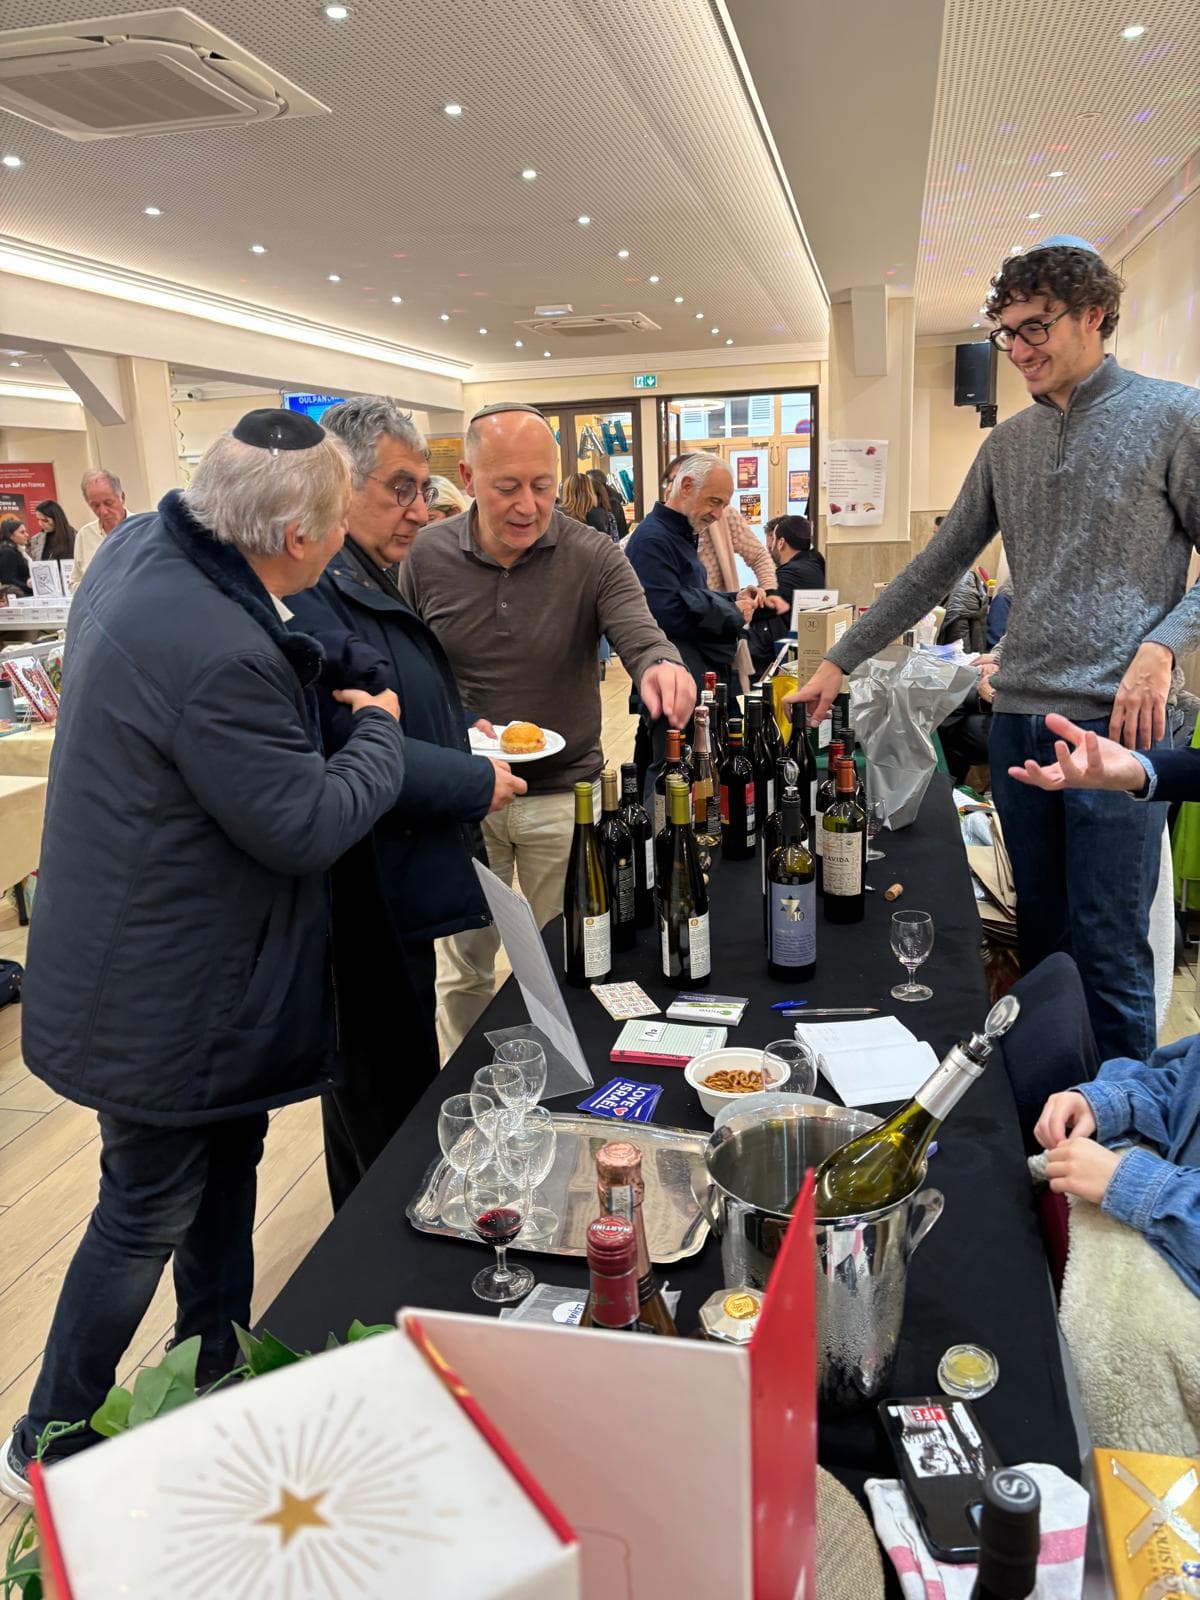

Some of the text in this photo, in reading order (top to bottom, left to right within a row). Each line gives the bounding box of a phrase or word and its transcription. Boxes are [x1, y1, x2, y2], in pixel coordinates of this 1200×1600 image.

[620, 1086, 652, 1108] LOVE
[592, 1224, 631, 1233] MARTINI
[912, 1408, 946, 1421] LIFE
